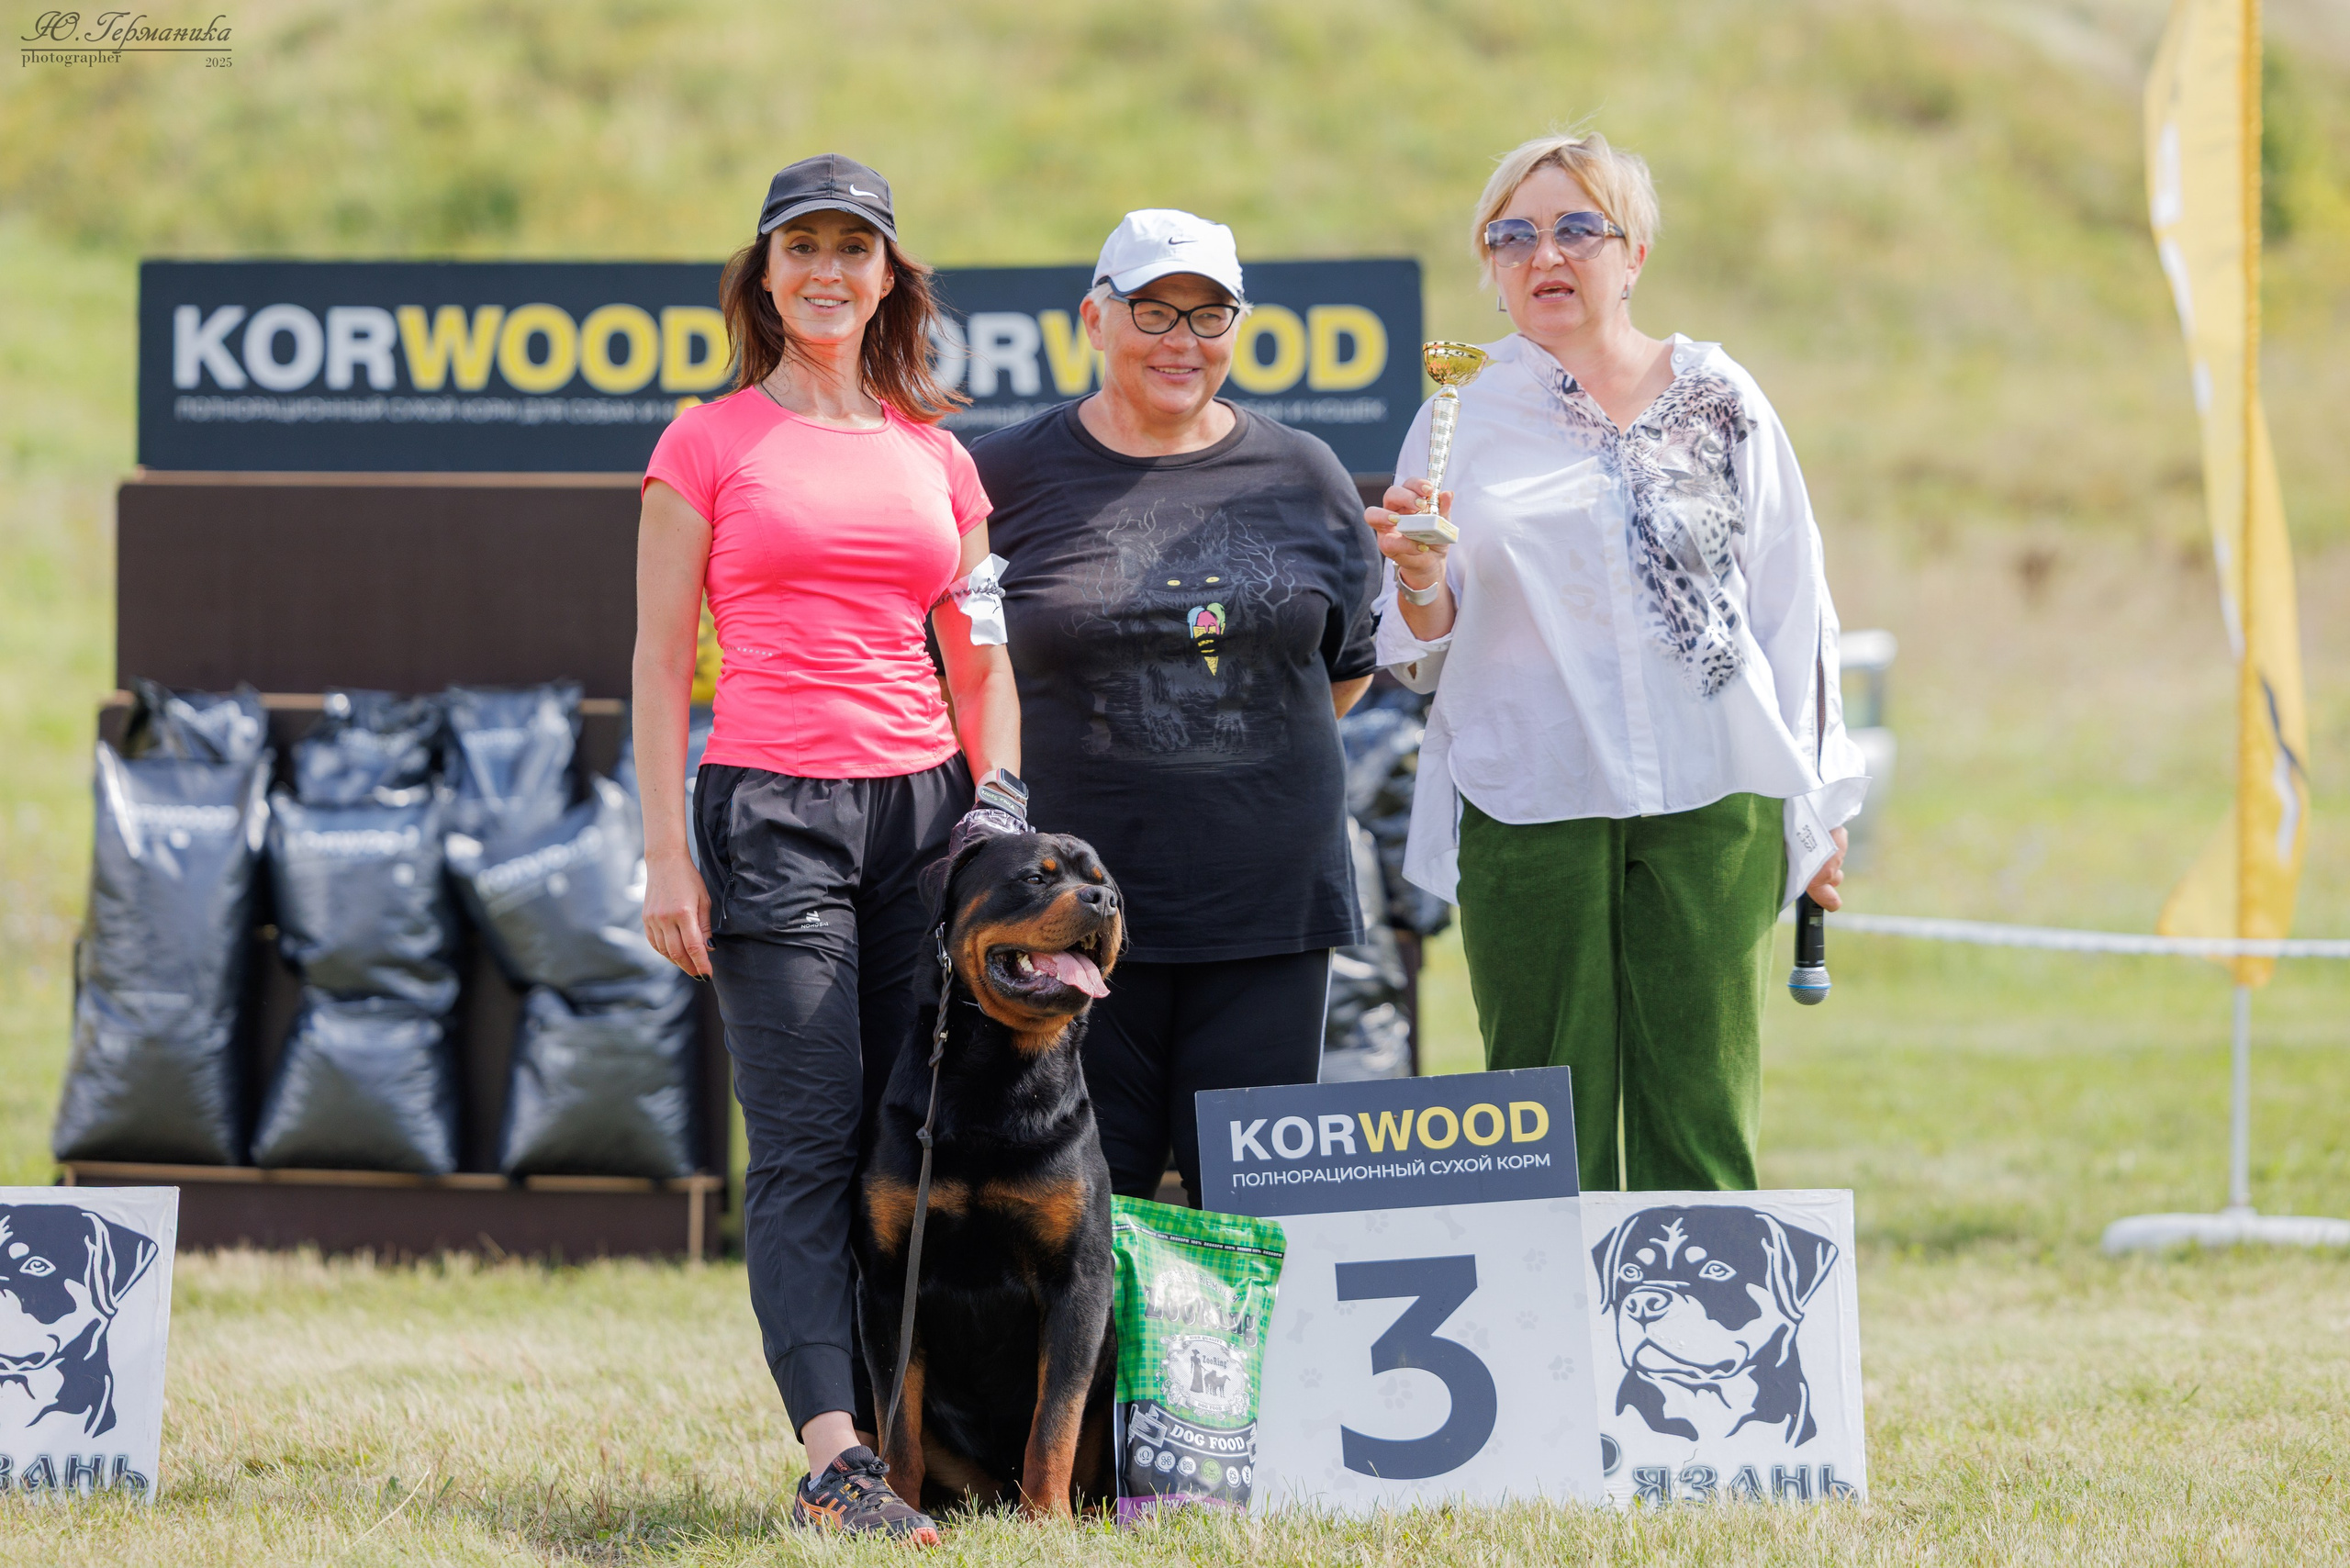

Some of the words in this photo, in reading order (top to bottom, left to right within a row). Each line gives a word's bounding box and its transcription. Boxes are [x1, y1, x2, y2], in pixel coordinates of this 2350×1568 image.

[173, 303, 733, 393] KORWOOD
[1229, 1101, 1550, 1162] KORWOOD
[1232, 1159, 1426, 1187] ПОЛНОРАЦИОННЫЙ
[1429, 1154, 1494, 1174] СУХОЙ
[1496, 1152, 1551, 1170] КОРМ
[1335, 1254, 1497, 1480] 3
[1169, 1424, 1205, 1447] DOG
[1209, 1436, 1245, 1450] FOOD
